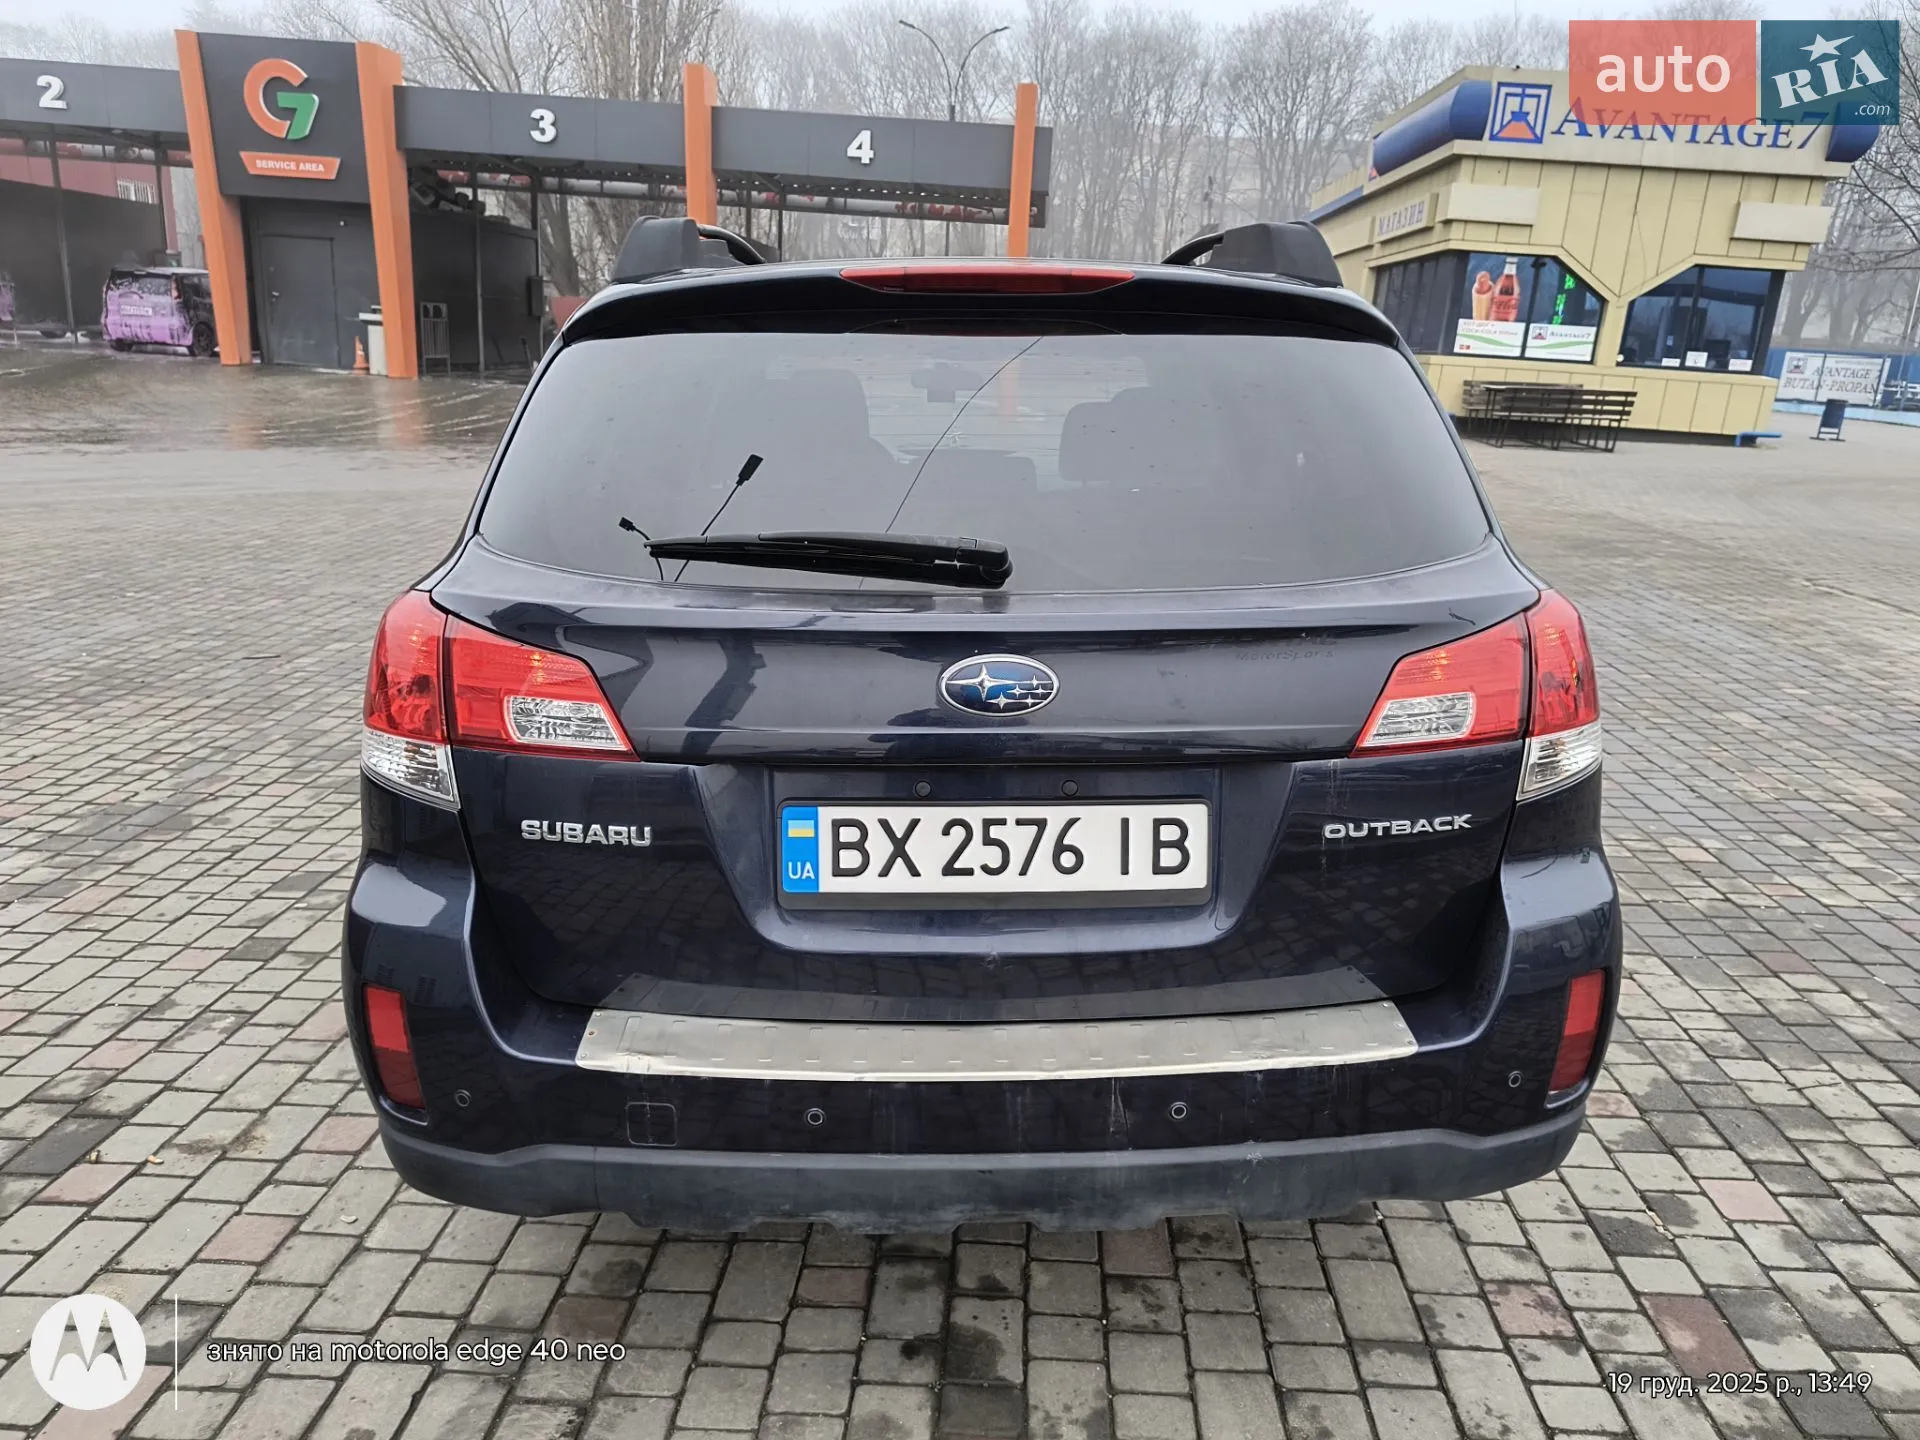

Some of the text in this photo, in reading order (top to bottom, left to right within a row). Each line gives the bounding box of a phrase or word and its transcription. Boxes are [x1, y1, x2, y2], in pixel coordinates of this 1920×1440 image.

[36, 74, 68, 110] 2
[529, 107, 558, 143] 3
[846, 129, 875, 164] 4
[255, 159, 325, 172] SERVICE AREA
[1377, 200, 1425, 236] МАГАЗИН
[521, 819, 652, 848] SUBARU
[1323, 814, 1473, 839] OUTBACK
[831, 817, 1190, 878] BX 2576 IB
[788, 861, 815, 881] UA
